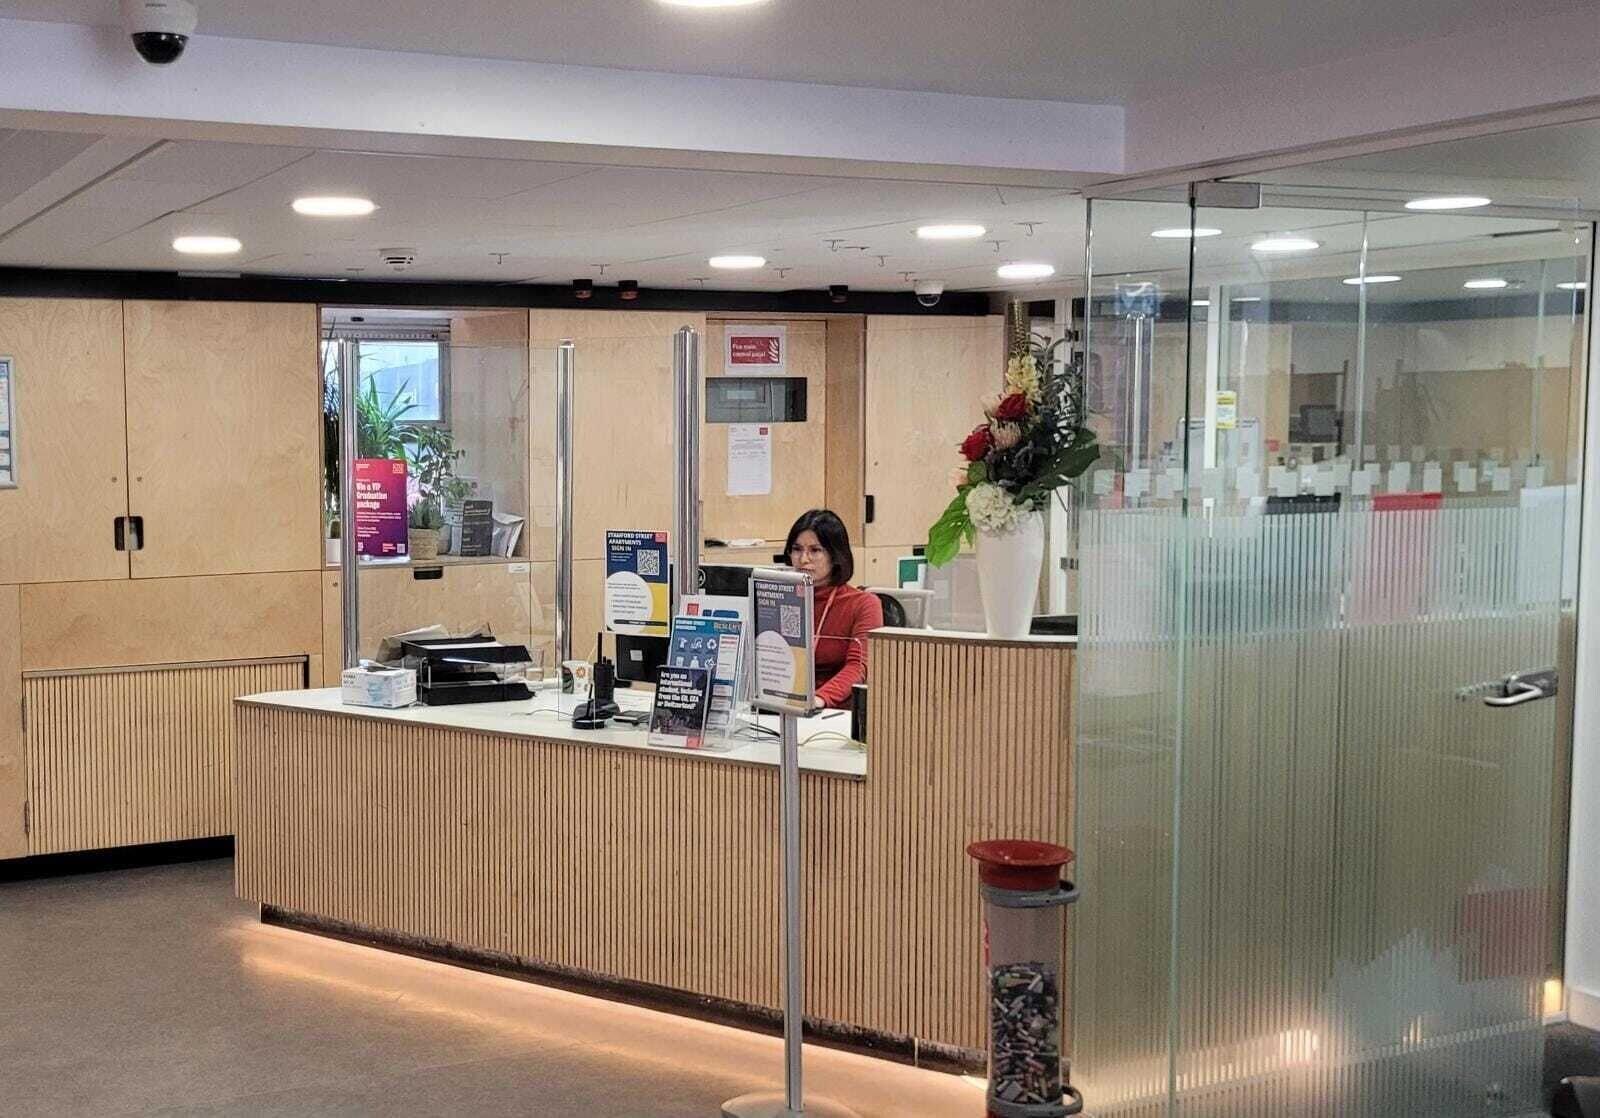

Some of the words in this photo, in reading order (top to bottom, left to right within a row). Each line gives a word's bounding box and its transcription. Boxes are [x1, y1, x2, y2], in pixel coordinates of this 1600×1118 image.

[372, 482, 381, 491] VIP
[356, 491, 388, 500] Graduation
[356, 500, 380, 510] package
[778, 585, 795, 593] STREET
[660, 679, 693, 688] international
